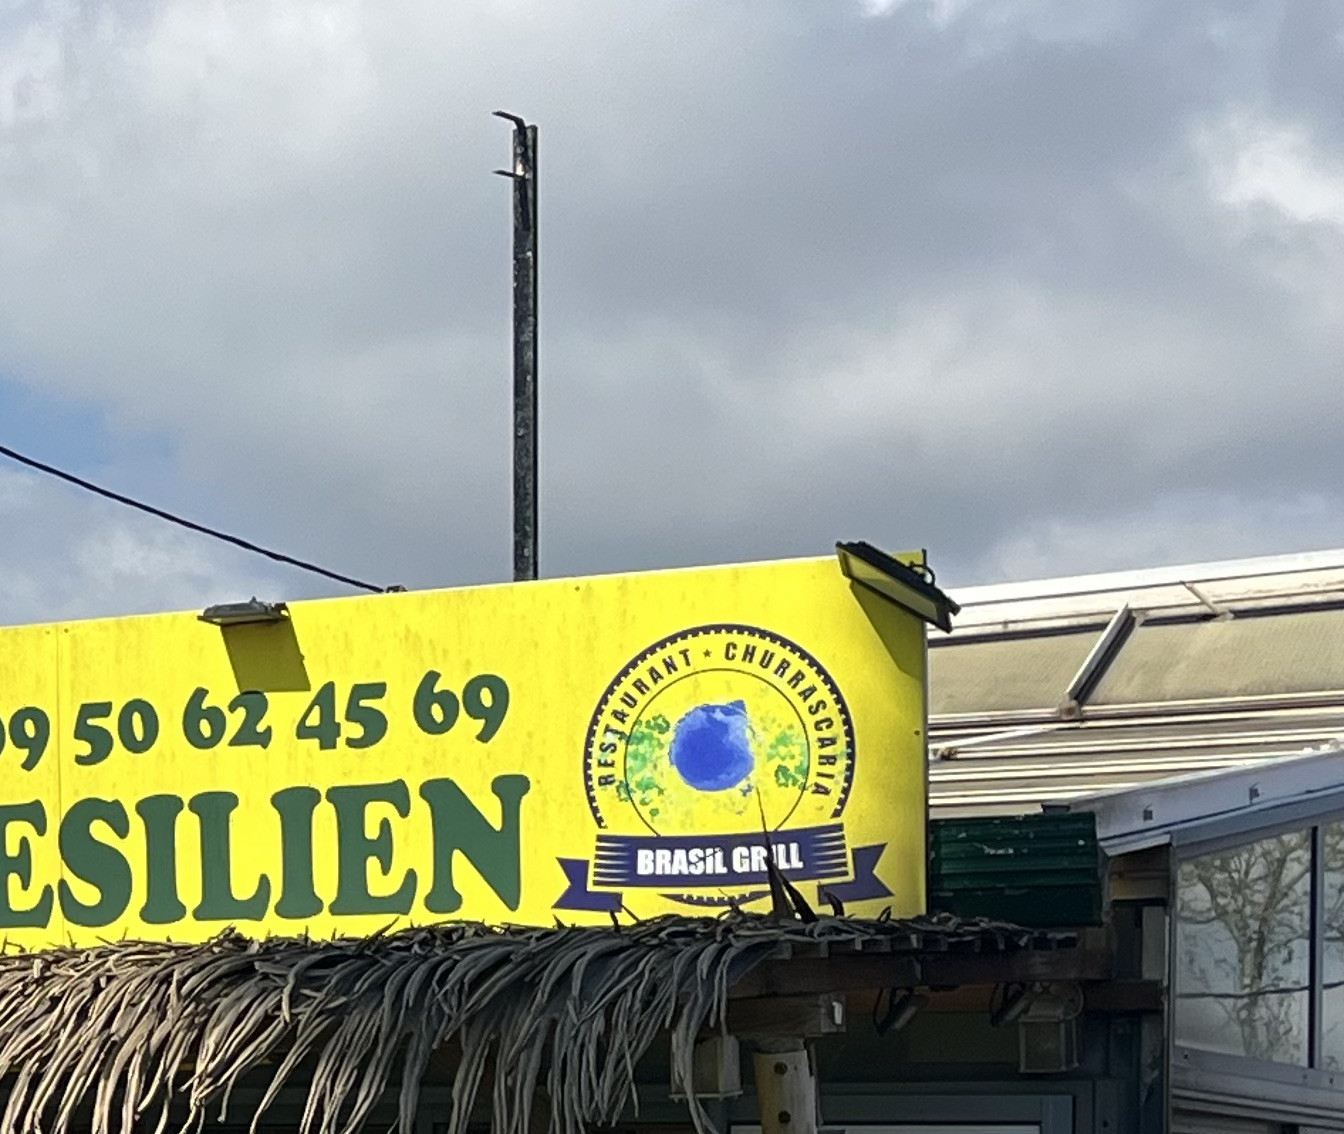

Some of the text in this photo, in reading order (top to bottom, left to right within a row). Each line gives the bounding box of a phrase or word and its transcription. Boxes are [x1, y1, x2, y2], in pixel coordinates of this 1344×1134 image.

[73, 698, 160, 766] 50
[182, 684, 273, 750] 62
[295, 681, 389, 751] 45
[412, 670, 510, 744] 69
[598, 641, 837, 797] RESTAURANT CHURRASCARIA
[637, 847, 728, 875] BRASIL
